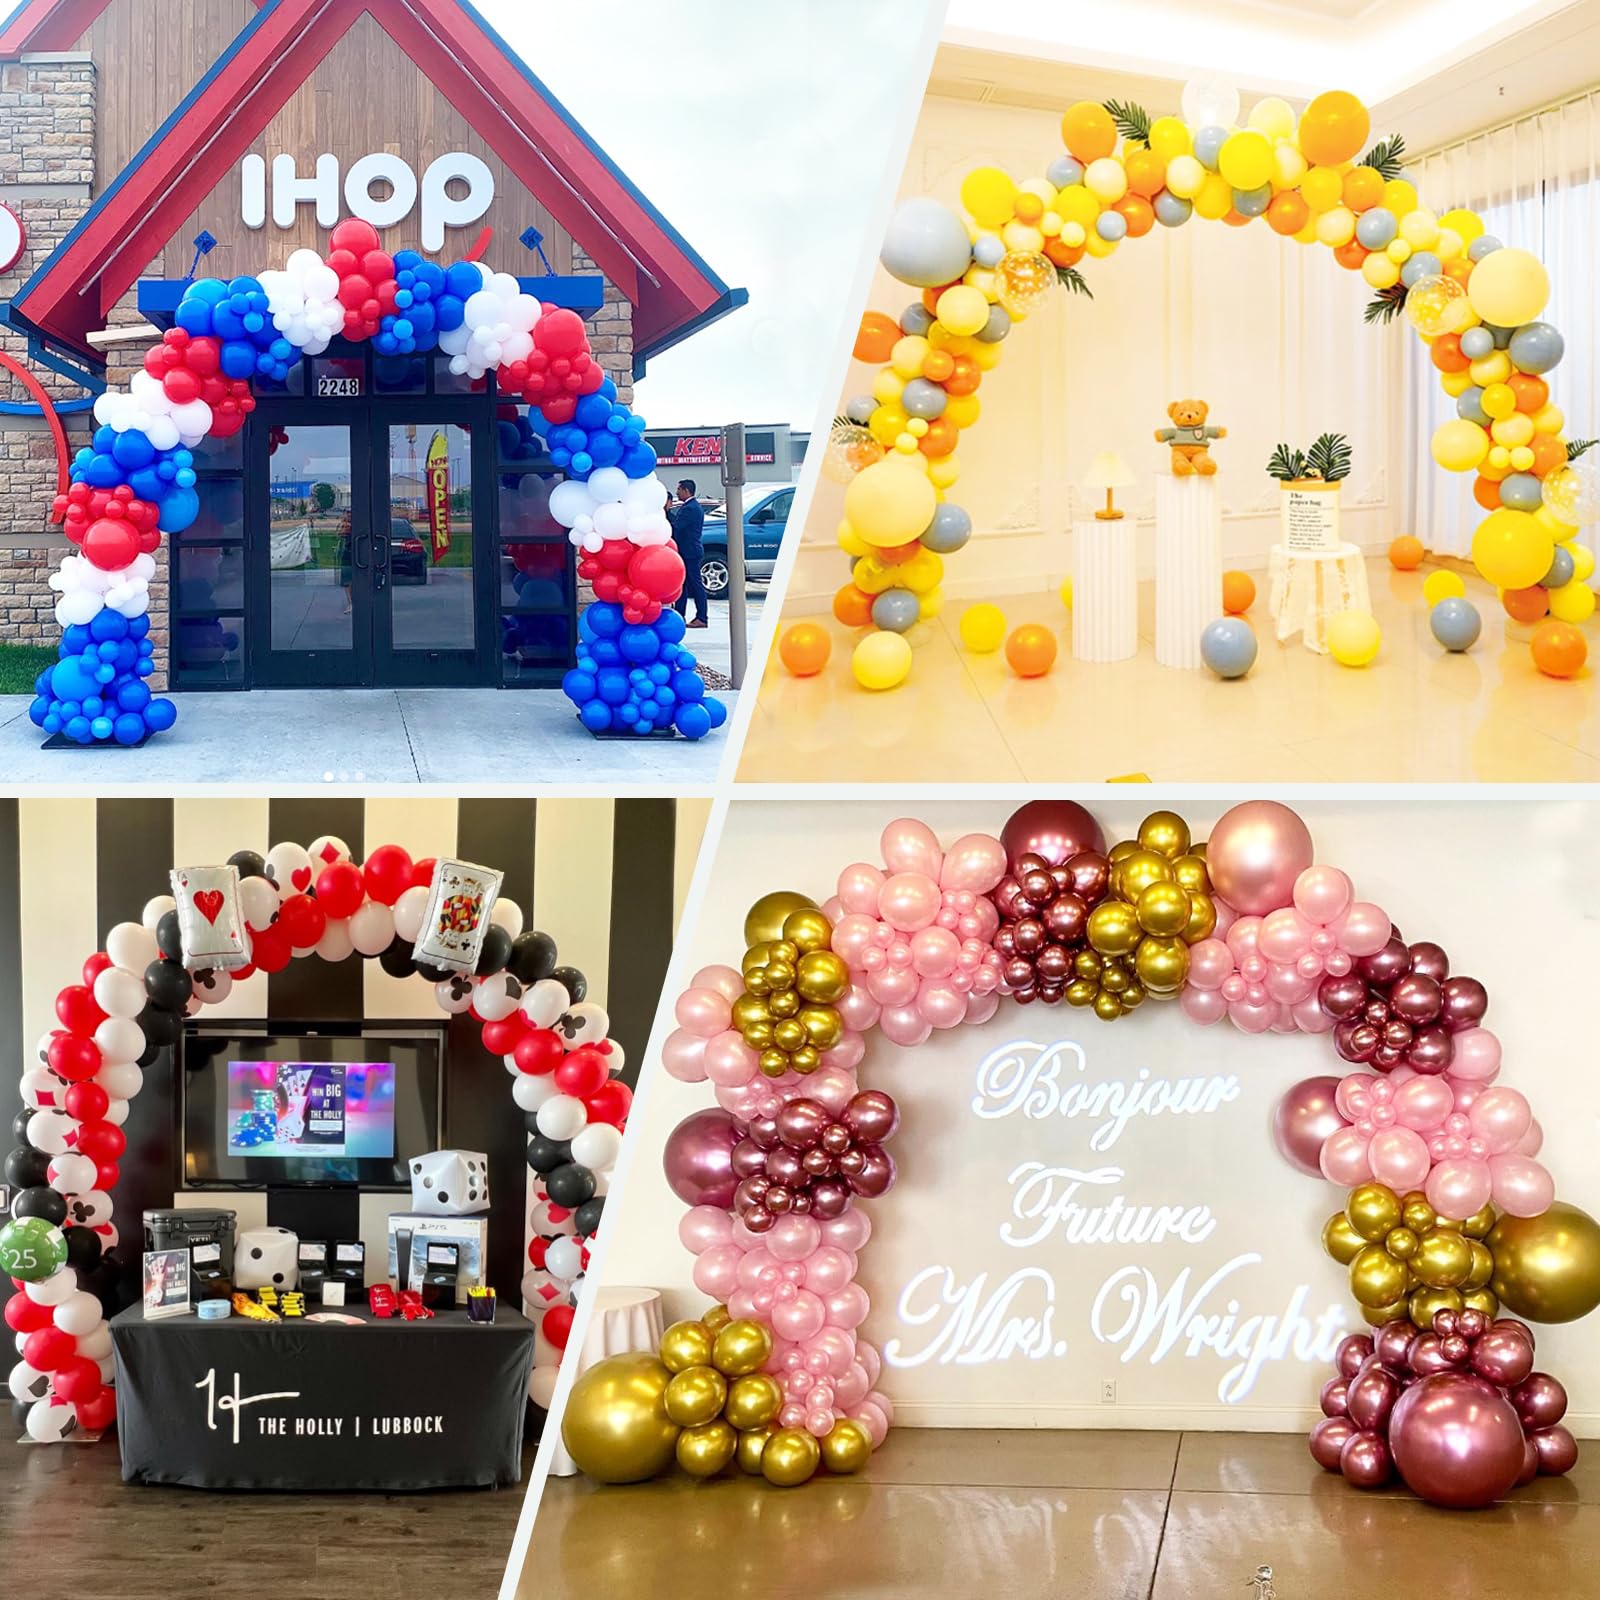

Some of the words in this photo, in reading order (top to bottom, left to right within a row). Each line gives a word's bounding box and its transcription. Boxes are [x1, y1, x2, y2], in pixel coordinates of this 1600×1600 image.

[319, 379, 358, 396] 2248
[433, 468, 449, 549] OPEN
[326, 1084, 341, 1097] BIG
[971, 1040, 1240, 1151] Bonjour
[323, 1099, 330, 1108] AT
[310, 1110, 322, 1119] THE
[323, 1110, 343, 1119] HOLLY
[1000, 1162, 1217, 1247] Future
[1, 1246, 37, 1269] $25
[885, 1265, 1067, 1368] Mrs.
[1092, 1253, 1348, 1404] Wright
[258, 1417, 287, 1435] THE
[295, 1417, 343, 1435] HOLLY
[372, 1415, 444, 1435] LUBBOCK
